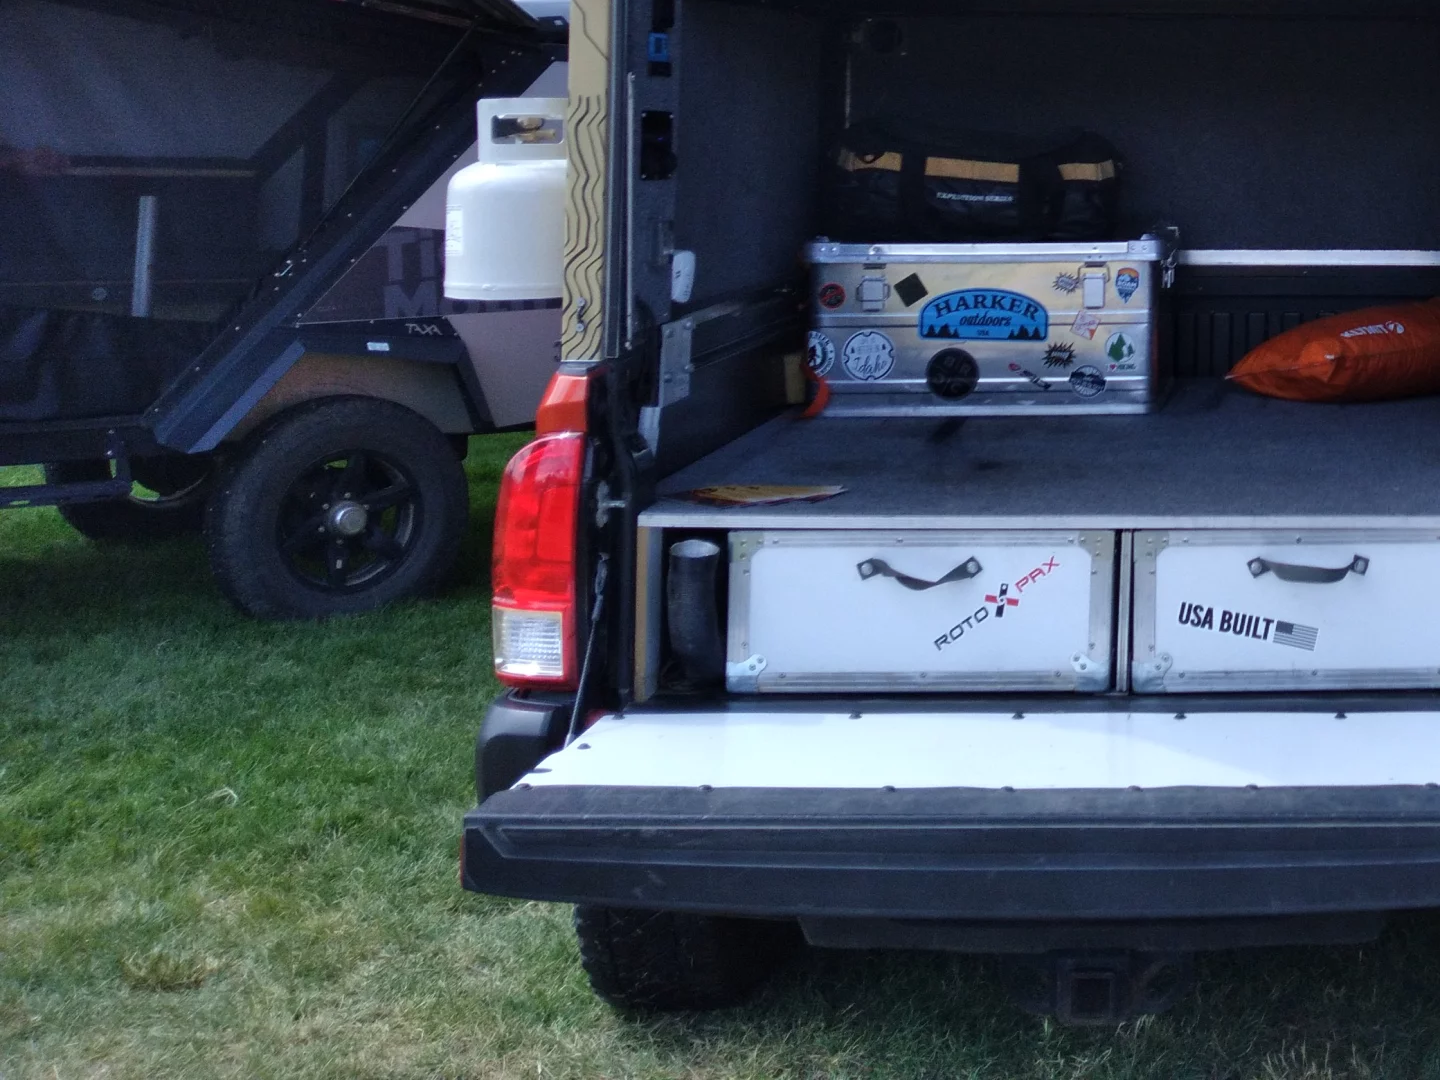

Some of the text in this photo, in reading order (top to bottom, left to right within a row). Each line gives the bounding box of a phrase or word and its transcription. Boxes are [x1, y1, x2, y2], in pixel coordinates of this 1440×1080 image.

[932, 293, 1040, 322] HARKER
[405, 322, 443, 336] TAXA
[1013, 555, 1060, 593] PAX
[933, 606, 990, 652] ROTO
[1178, 601, 1275, 641] USA BUILT
